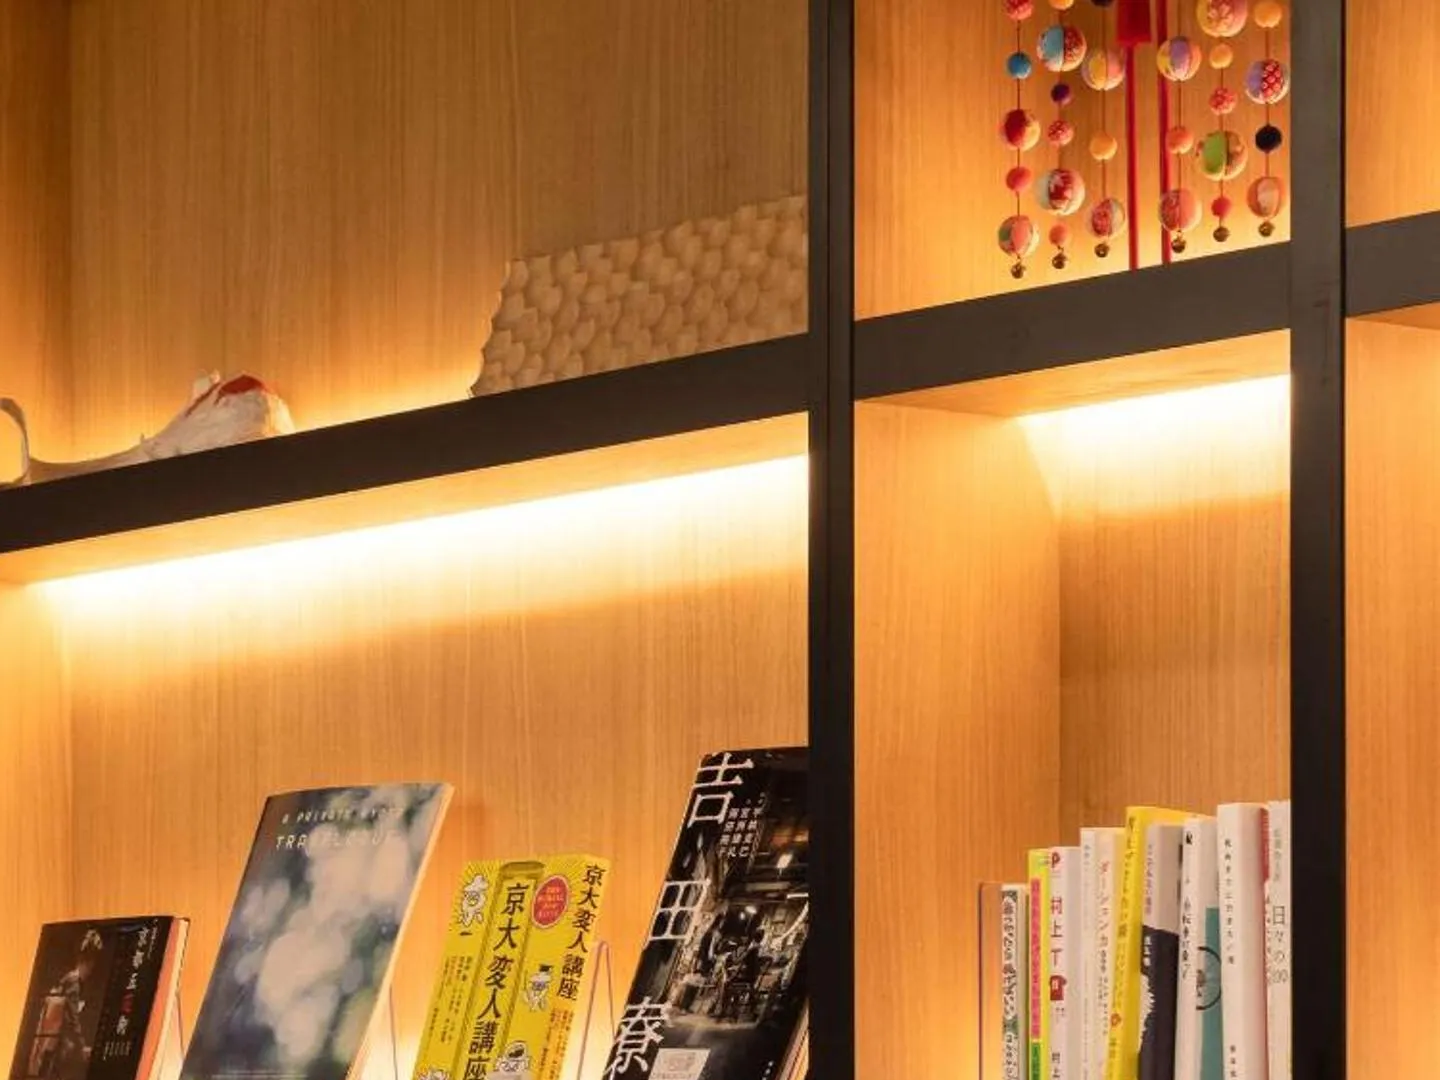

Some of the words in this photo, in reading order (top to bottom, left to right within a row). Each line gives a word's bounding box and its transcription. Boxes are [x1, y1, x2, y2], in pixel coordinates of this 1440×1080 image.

[556, 864, 606, 1001] 京大変人講座
